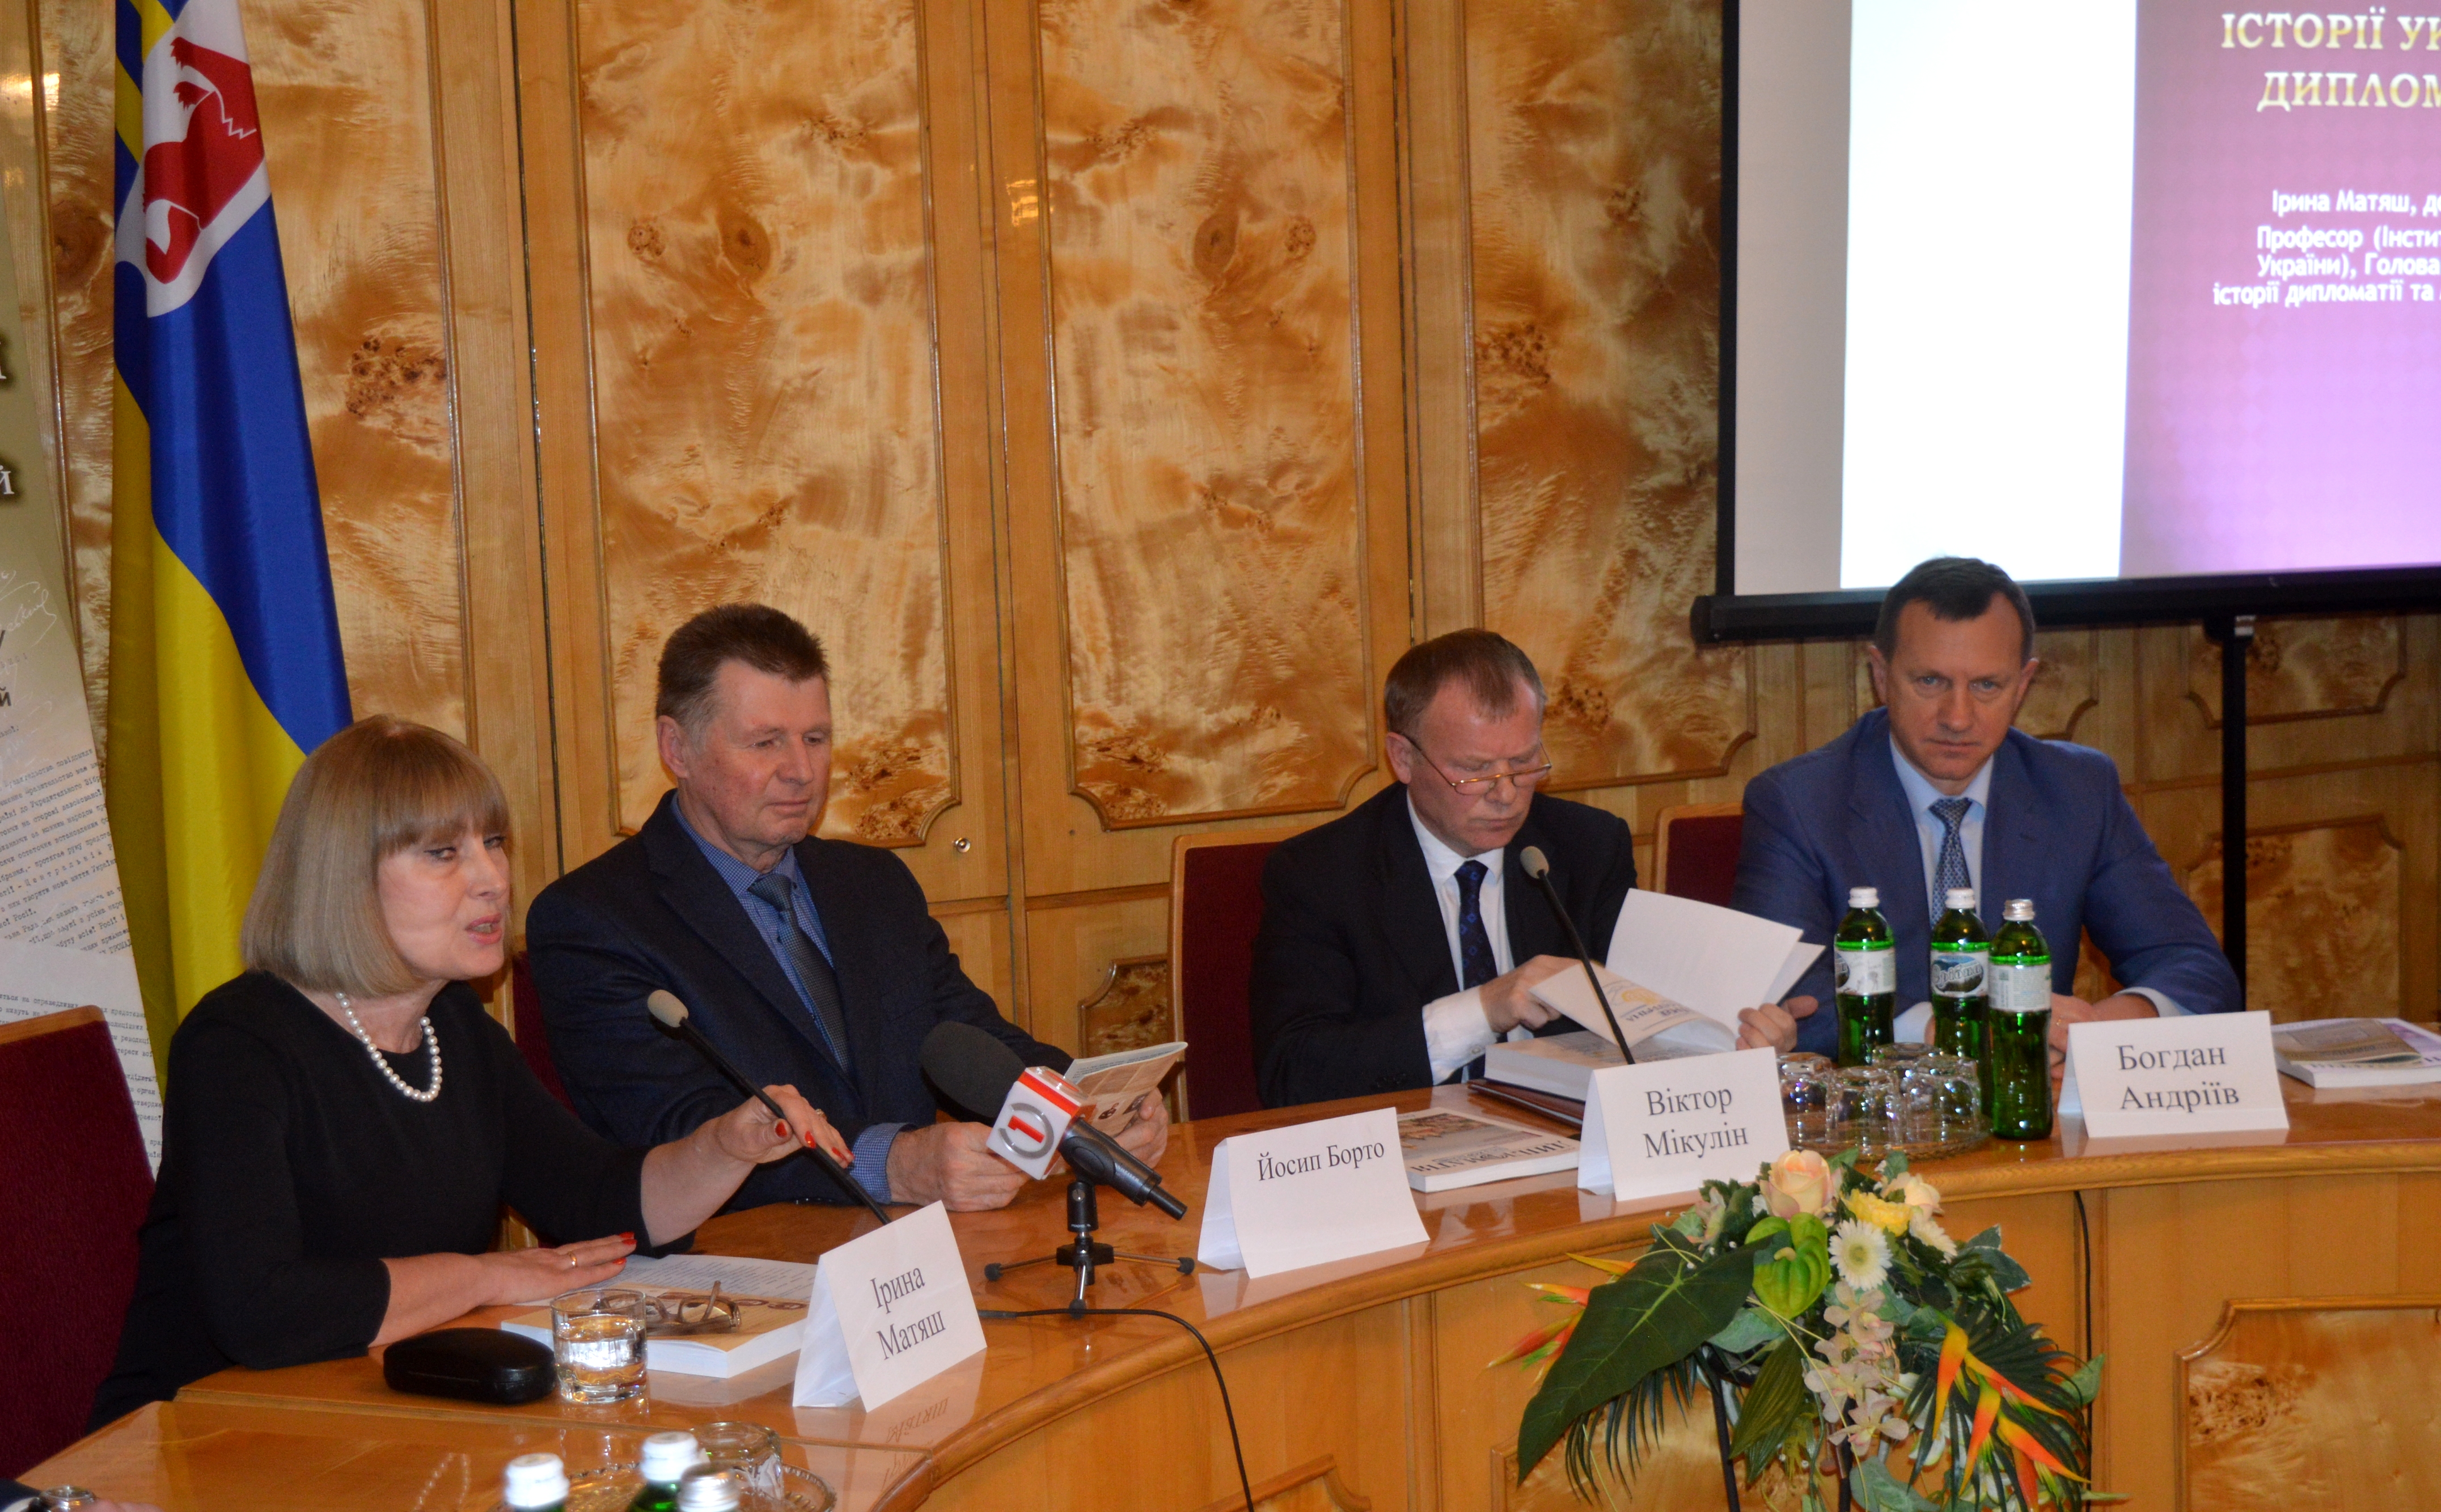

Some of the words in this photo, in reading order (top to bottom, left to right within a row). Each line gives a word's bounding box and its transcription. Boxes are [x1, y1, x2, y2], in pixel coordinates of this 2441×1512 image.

[2221, 6, 2385, 49] ІСТОРІЇ
[2272, 189, 2330, 217] Ірина
[2336, 189, 2417, 217] Матяш,
[2257, 225, 2363, 253] Професор
[2374, 225, 2441, 252] (Інсти
[2257, 253, 2357, 281] України),
[2364, 251, 2441, 276] Голова
[2212, 281, 2280, 309] історії
[2285, 278, 2405, 308] дипломатії
[2410, 283, 2434, 302] та
[2116, 1045, 2226, 1070] Богдан
[1645, 1087, 1732, 1116] Віктор
[2120, 1081, 2239, 1112] Андріїв
[1643, 1122, 1749, 1158] Мікулін
[1257, 1152, 1322, 1181] Йосип
[1327, 1142, 1385, 1170] Борто
[870, 1267, 925, 1314] Ірина
[876, 1310, 946, 1361] Матяш
